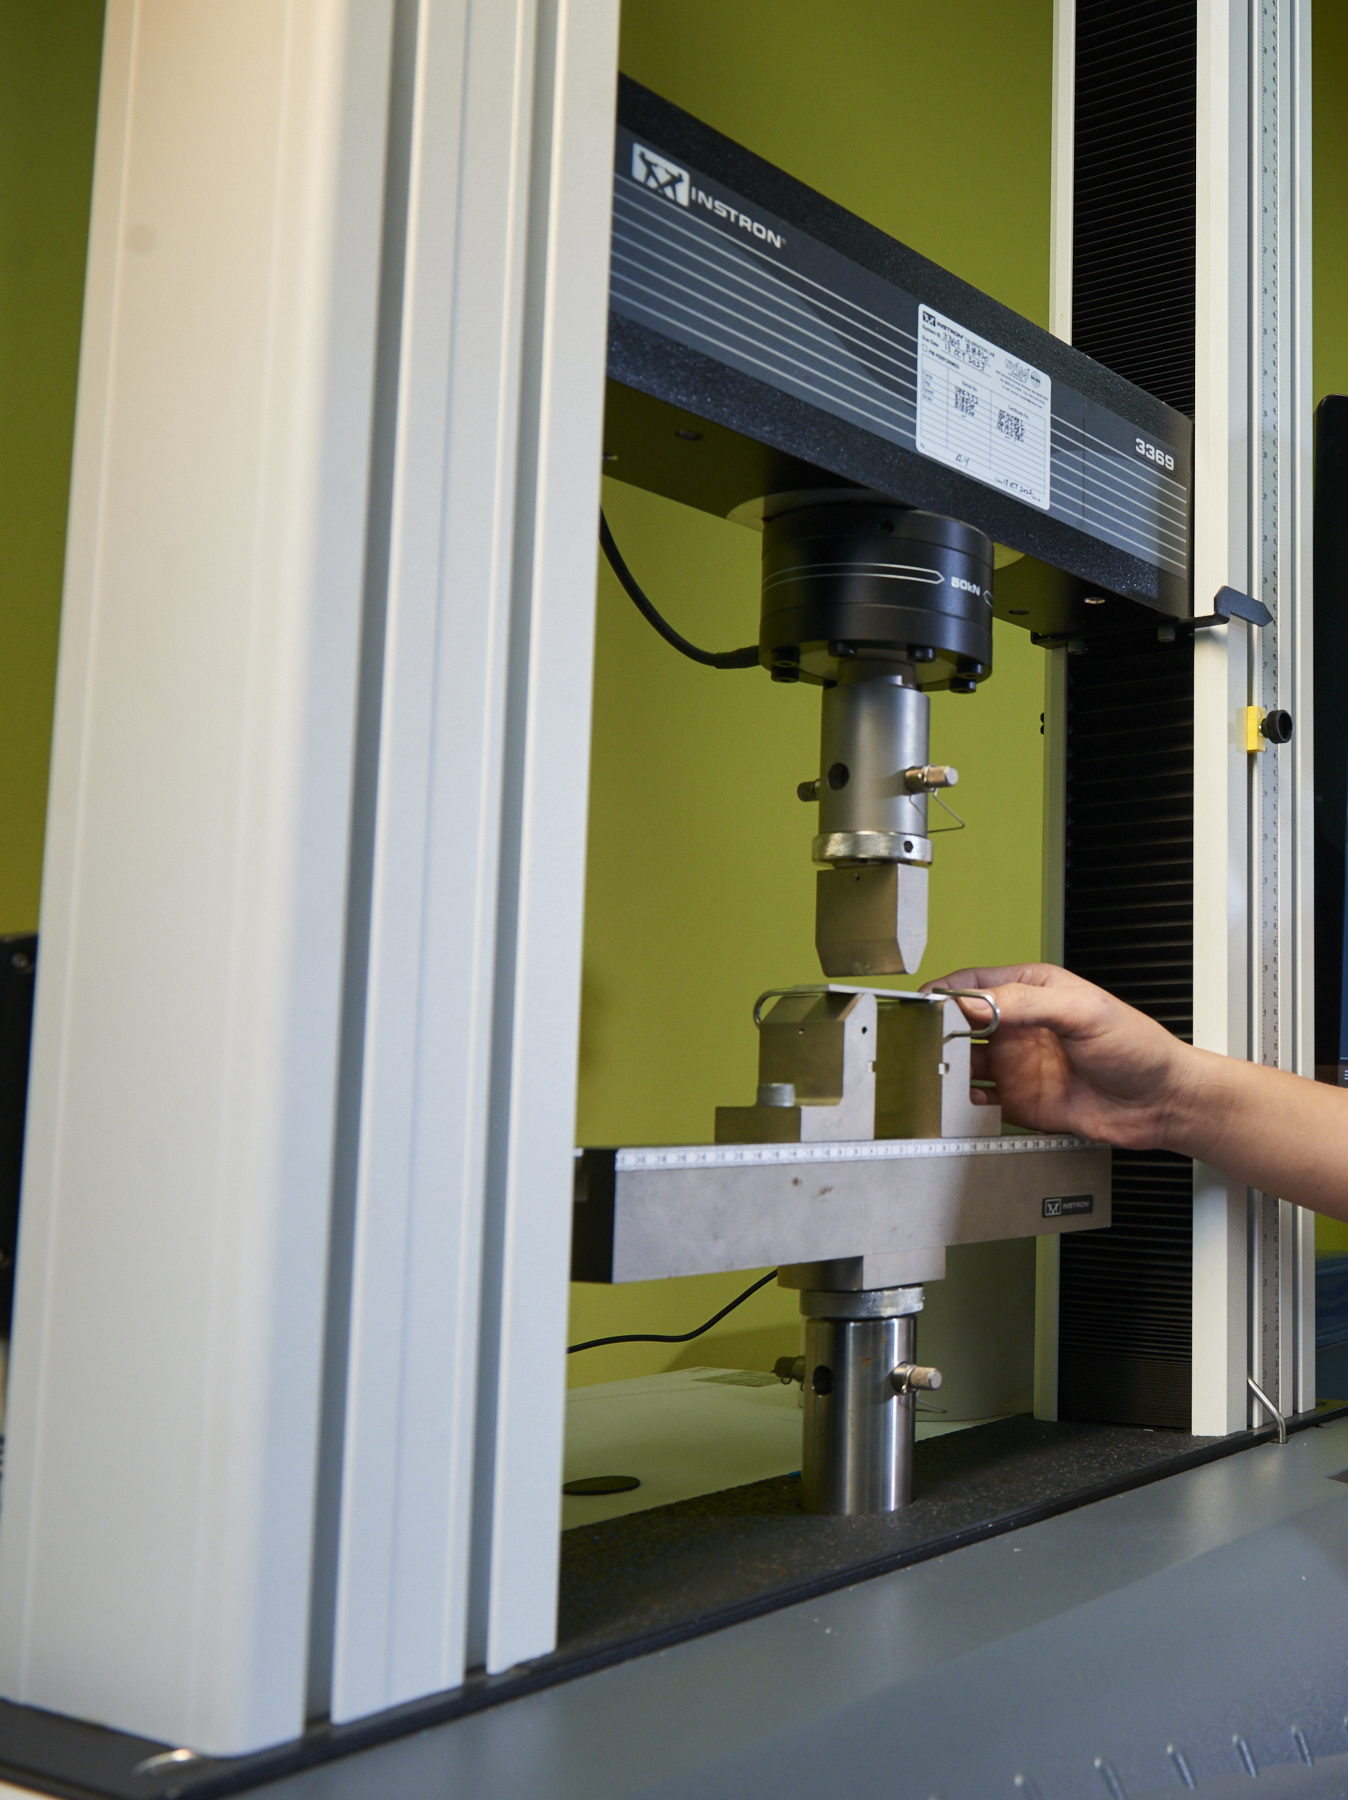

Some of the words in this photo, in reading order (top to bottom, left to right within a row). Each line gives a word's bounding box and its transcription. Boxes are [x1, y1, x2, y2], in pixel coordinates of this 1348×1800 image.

[691, 186, 781, 248] INSTRON
[1135, 438, 1174, 471] 3369
[951, 576, 981, 596] 50kN
[1062, 1201, 1090, 1209] INSTRON
